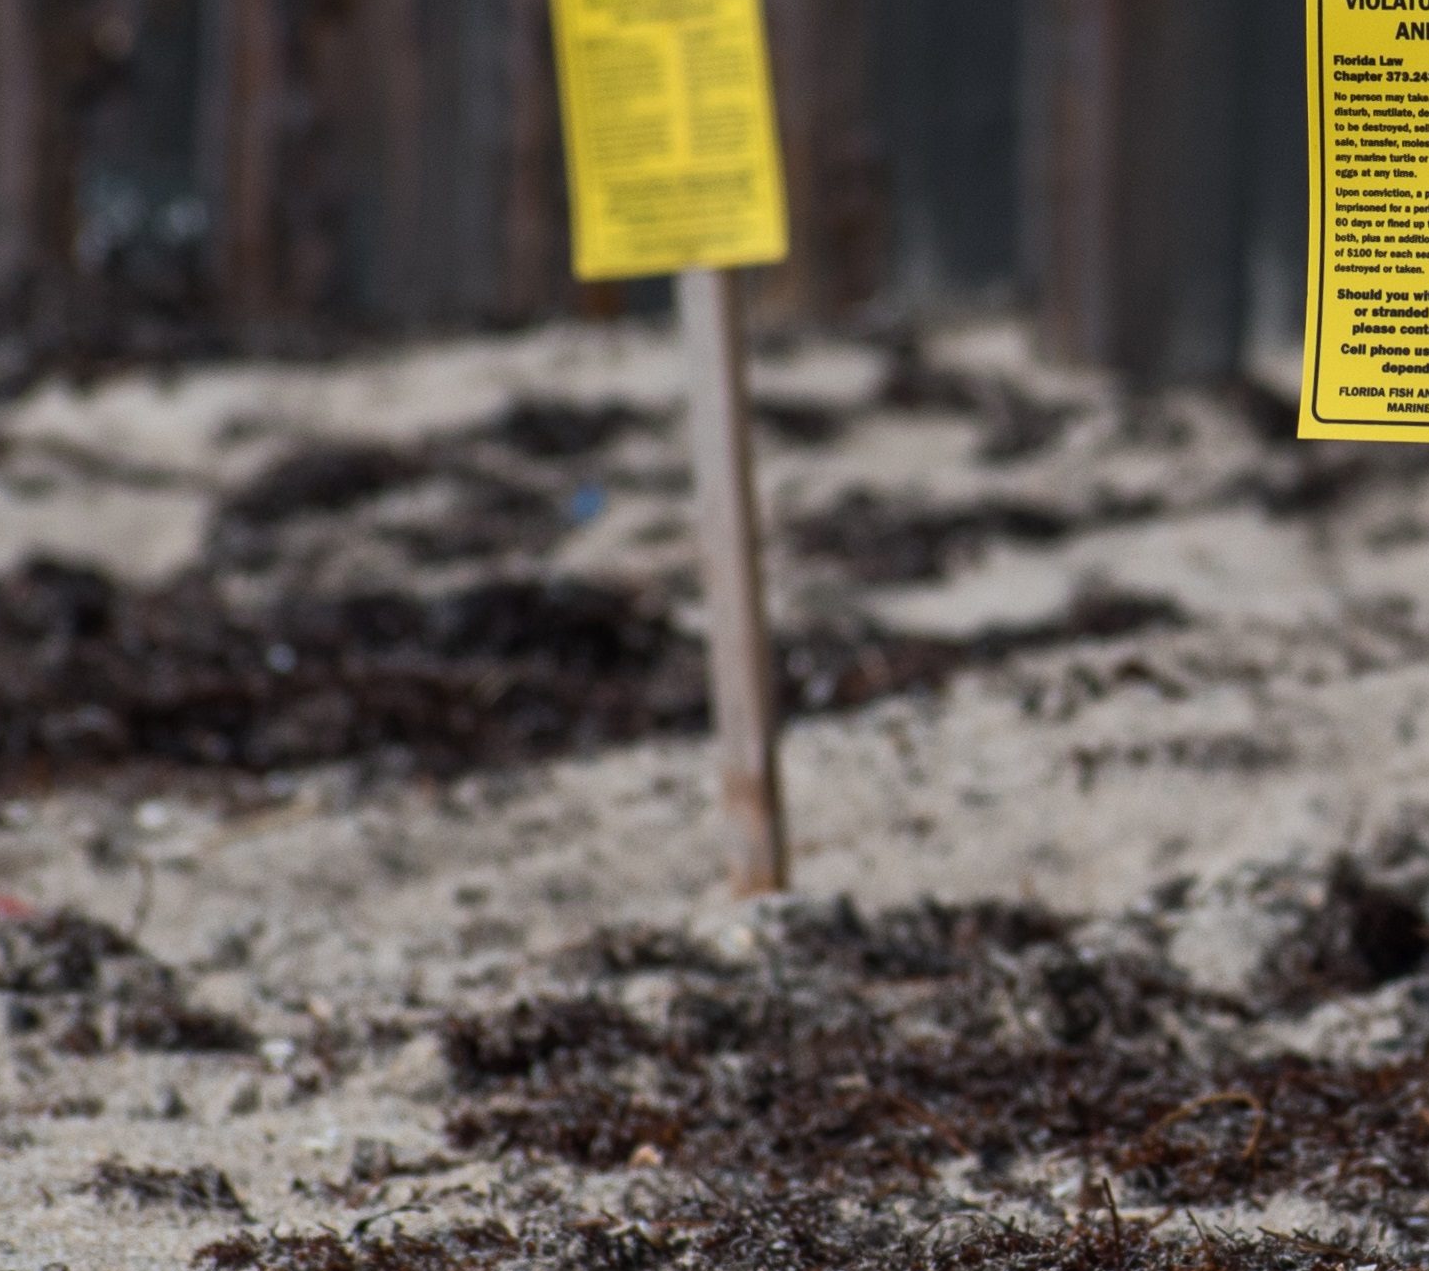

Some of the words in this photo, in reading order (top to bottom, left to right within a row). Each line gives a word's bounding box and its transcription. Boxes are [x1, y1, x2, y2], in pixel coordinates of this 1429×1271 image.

[1333, 54, 1376, 66] Florida
[1379, 55, 1403, 66] Law
[1333, 70, 1383, 84] Chapter
[1334, 91, 1347, 101] No
[1350, 94, 1383, 103] person
[1385, 94, 1405, 104] may
[1334, 122, 1345, 132] to
[1347, 122, 1359, 132] be
[1335, 168, 1359, 179] eggs
[1361, 168, 1371, 177] at
[1373, 170, 1391, 180] any
[1335, 187, 1360, 198] Upon
[1416, 190, 1422, 198] a
[1335, 202, 1387, 214] imprisoned
[1389, 203, 1402, 213] for
[1405, 205, 1411, 213] a
[1335, 217, 1348, 227] 60
[1351, 218, 1373, 229] days
[1375, 220, 1385, 228] or
[1387, 218, 1411, 228] fined
[1413, 221, 1425, 230] up
[1334, 263, 1380, 275] destroyed
[1383, 266, 1393, 274] or
[1337, 288, 1382, 301] Should
[1386, 292, 1409, 303] you
[1354, 308, 1368, 317] or
[1371, 306, 1429, 318] stranded
[1352, 322, 1397, 336] please
[1340, 343, 1367, 355] Cell
[1369, 344, 1411, 358] phone
[1339, 386, 1385, 397] FLORIDA
[1389, 387, 1414, 398] FISH
